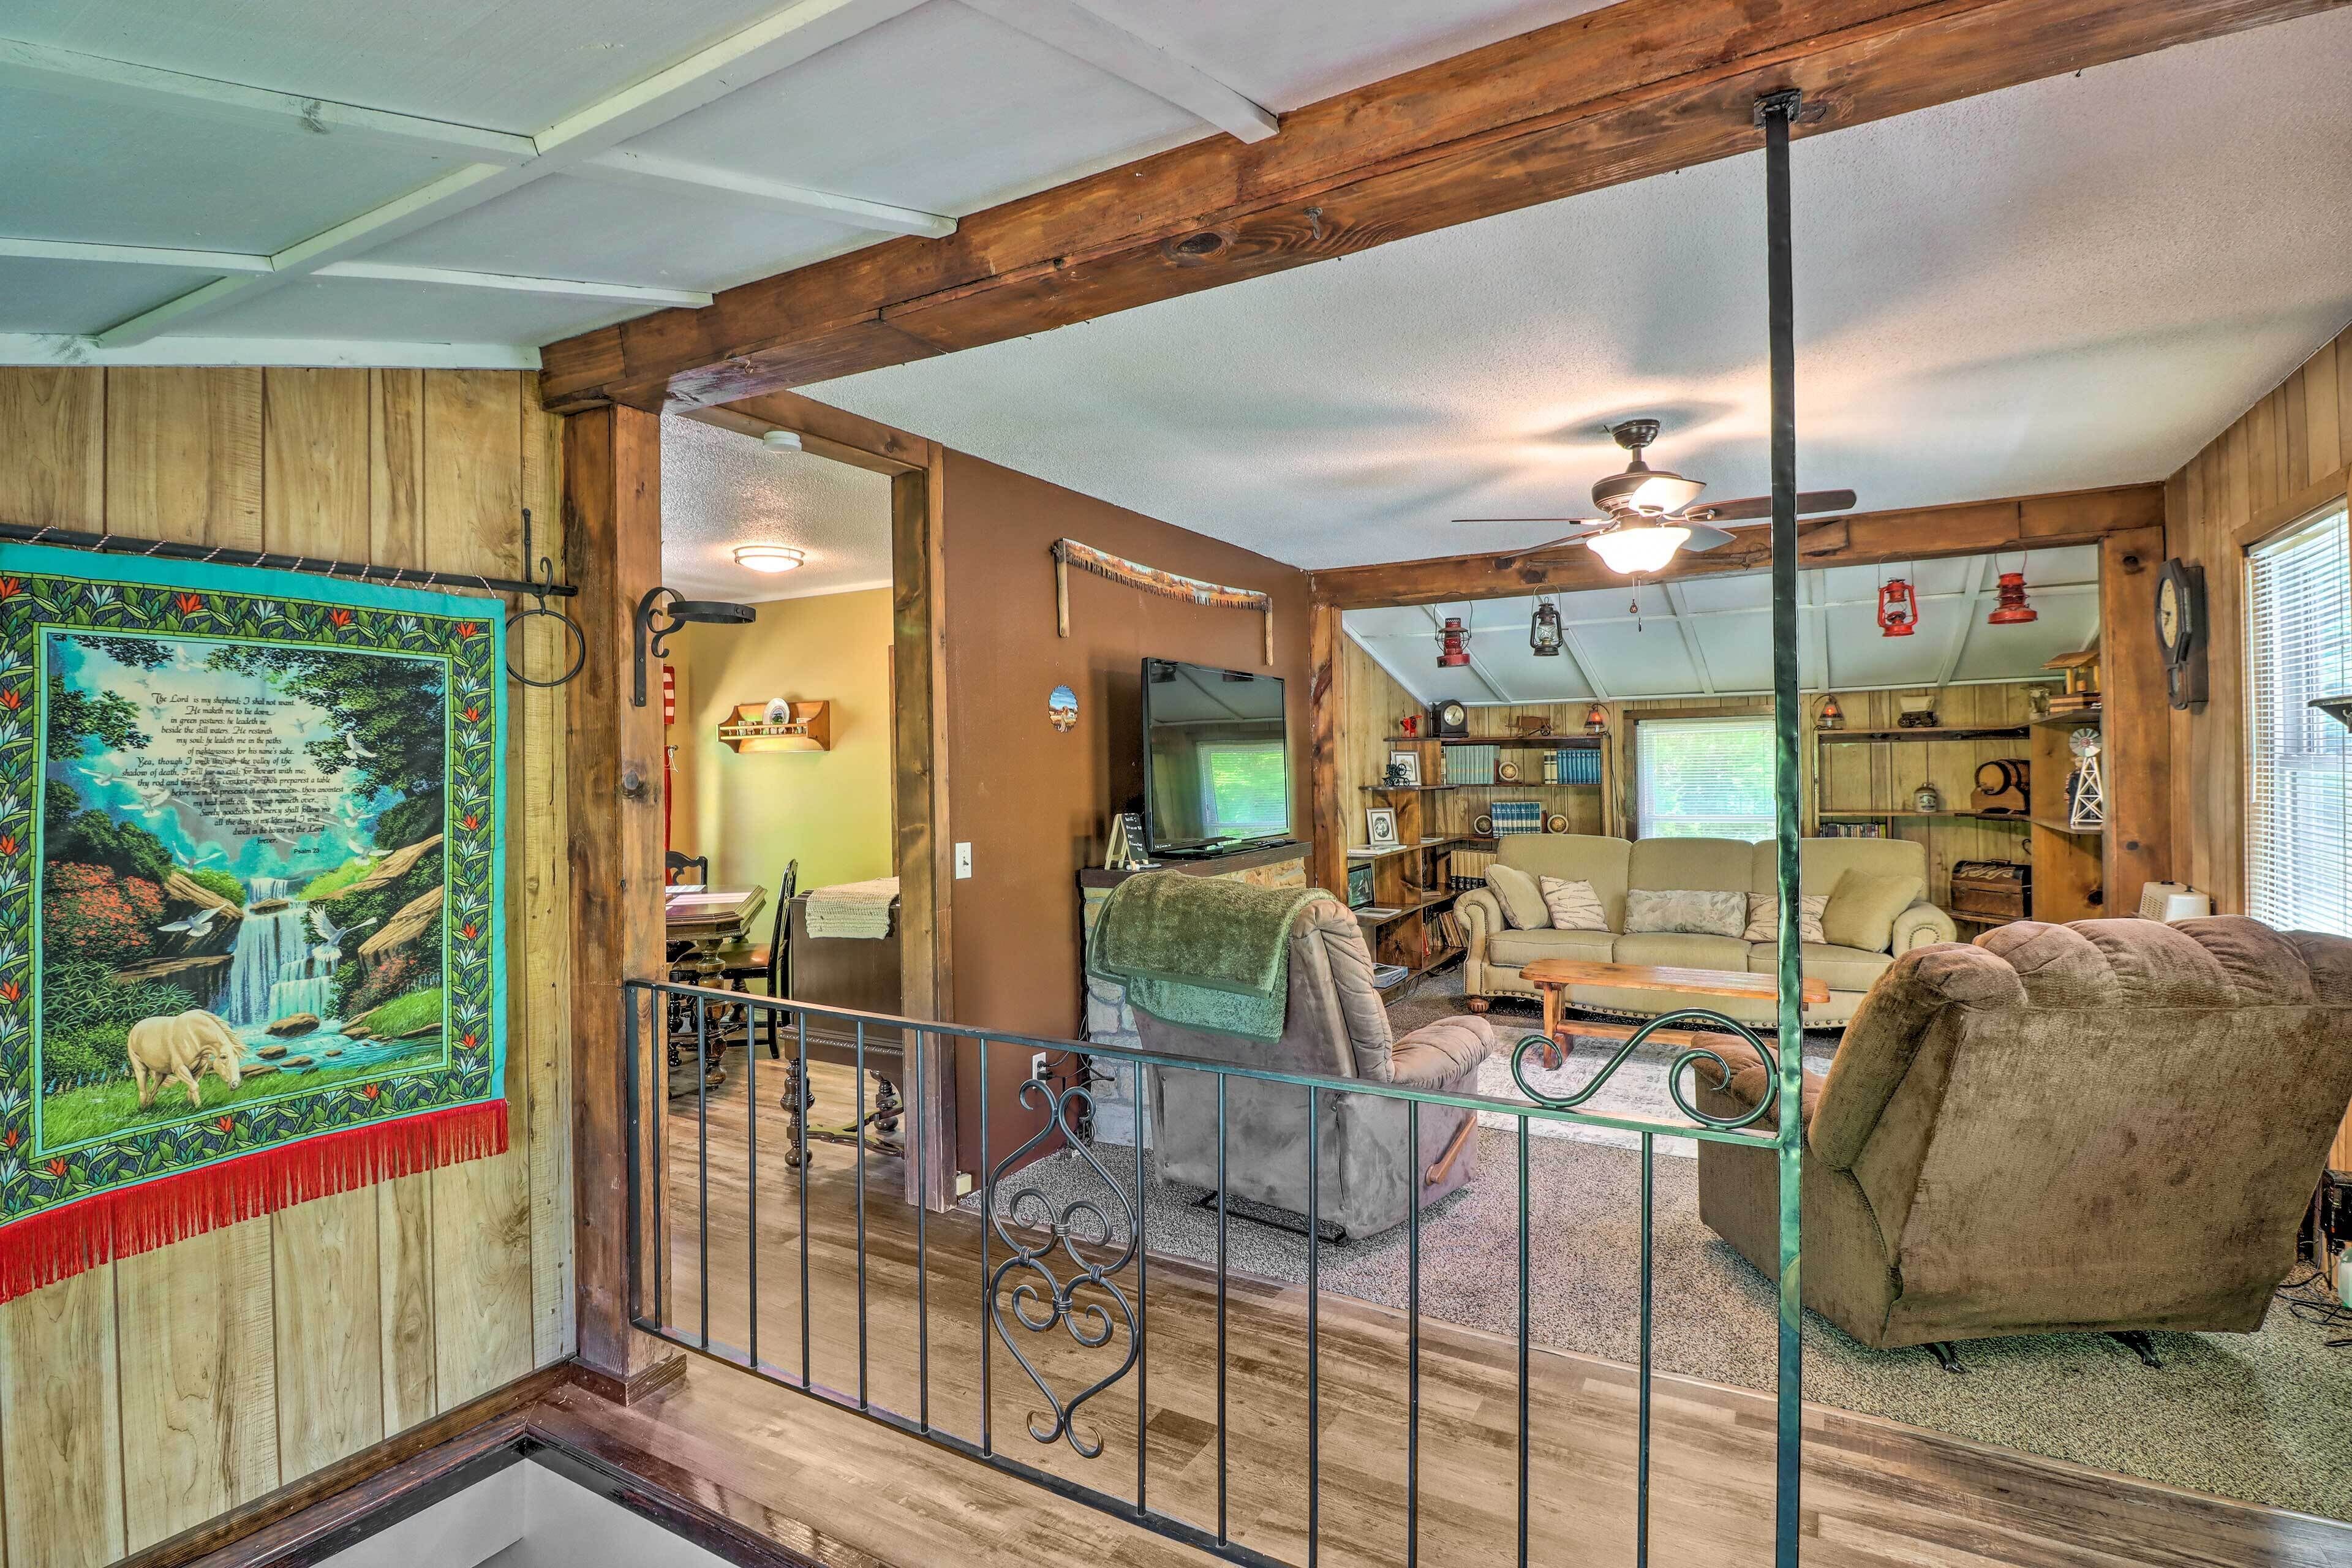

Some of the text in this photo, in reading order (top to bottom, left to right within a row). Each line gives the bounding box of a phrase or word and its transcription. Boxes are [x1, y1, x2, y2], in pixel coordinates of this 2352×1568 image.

[151, 693, 167, 704] The
[169, 694, 189, 703] Lord
[185, 706, 200, 715] He
[205, 736, 213, 745] he
[266, 737, 282, 746] paths
[136, 756, 154, 767] Yea,
[158, 758, 183, 767] though
[212, 757, 236, 767] through
[253, 758, 270, 767] valley
[281, 757, 291, 766] the
[150, 768, 157, 777] of
[137, 780, 149, 789] thy
[181, 779, 191, 788] thy
[192, 778, 206, 787] staff
[209, 778, 221, 787] they
[301, 786, 315, 795] thou
[200, 809, 220, 818] Surely
[222, 808, 251, 818] goodness
[285, 805, 299, 815] shall
[237, 818, 252, 827] days
[257, 837, 277, 846] forever.
